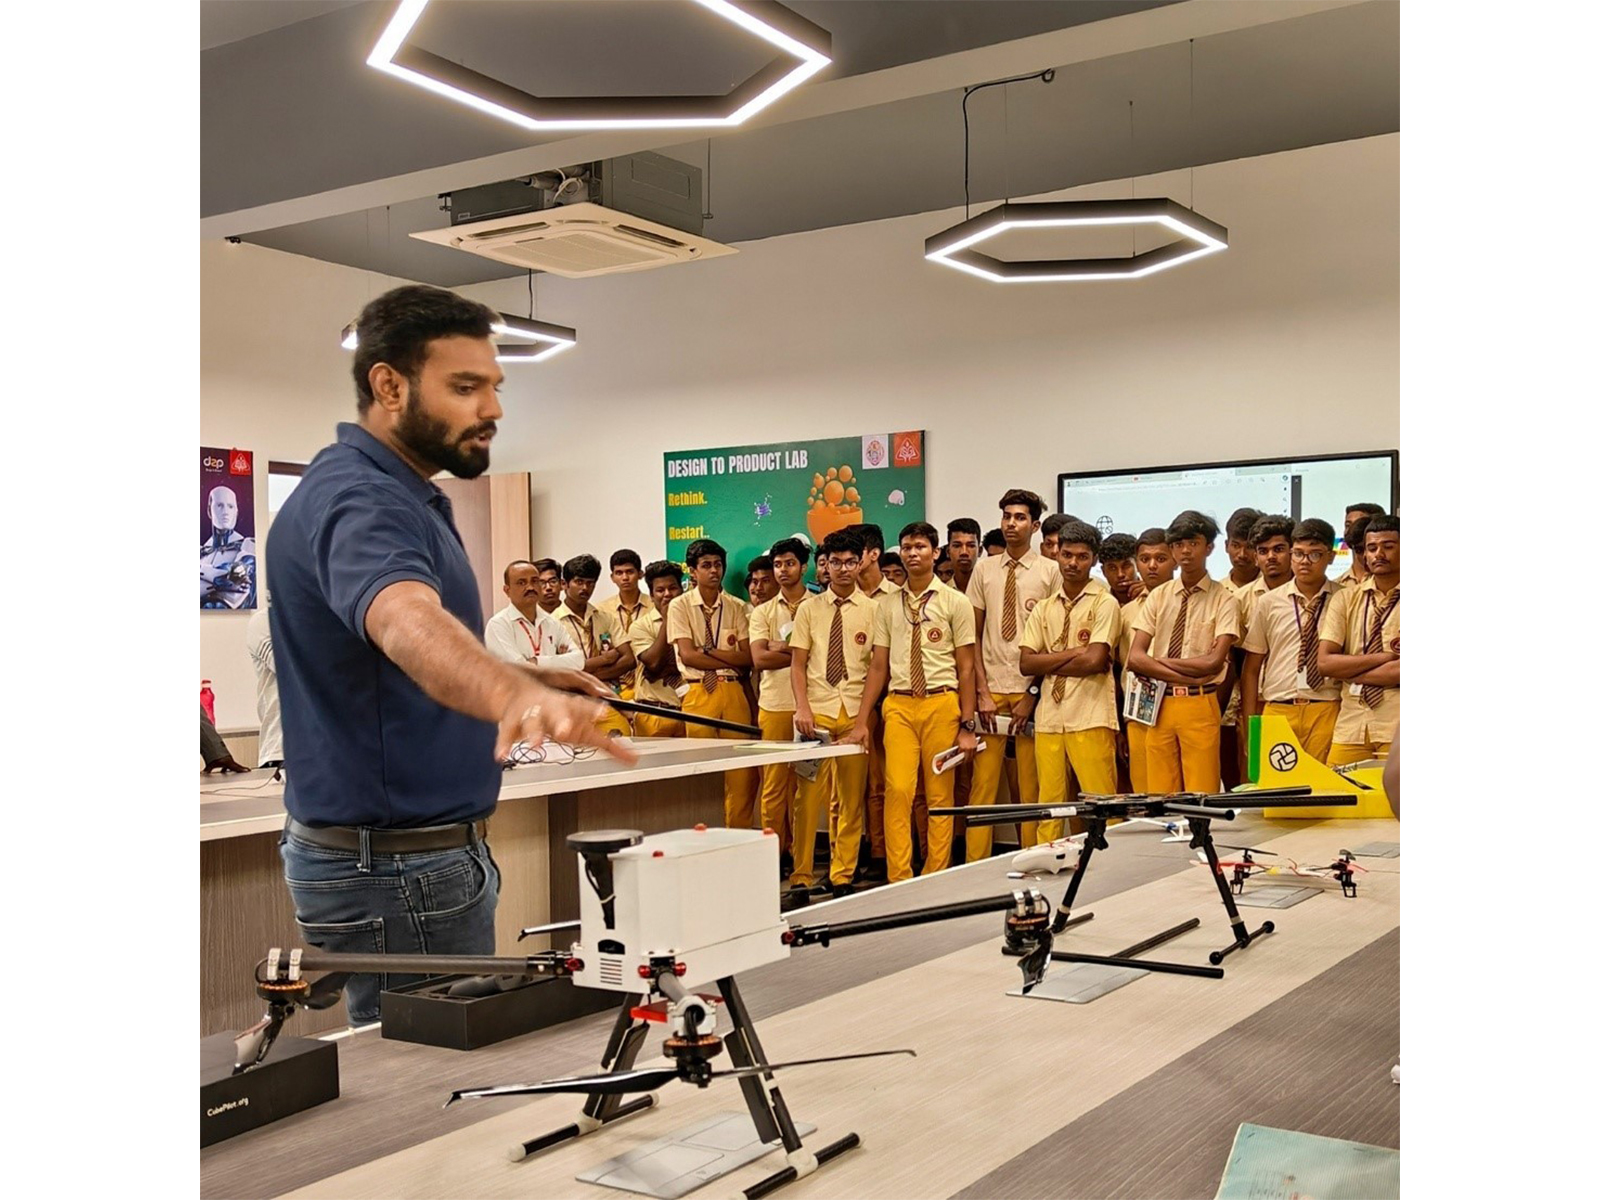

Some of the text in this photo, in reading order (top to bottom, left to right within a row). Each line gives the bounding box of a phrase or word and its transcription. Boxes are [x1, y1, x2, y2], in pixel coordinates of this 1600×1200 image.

[667, 449, 808, 478] DESIGN TO PRODUCT LAB
[668, 491, 708, 506] Rethink.
